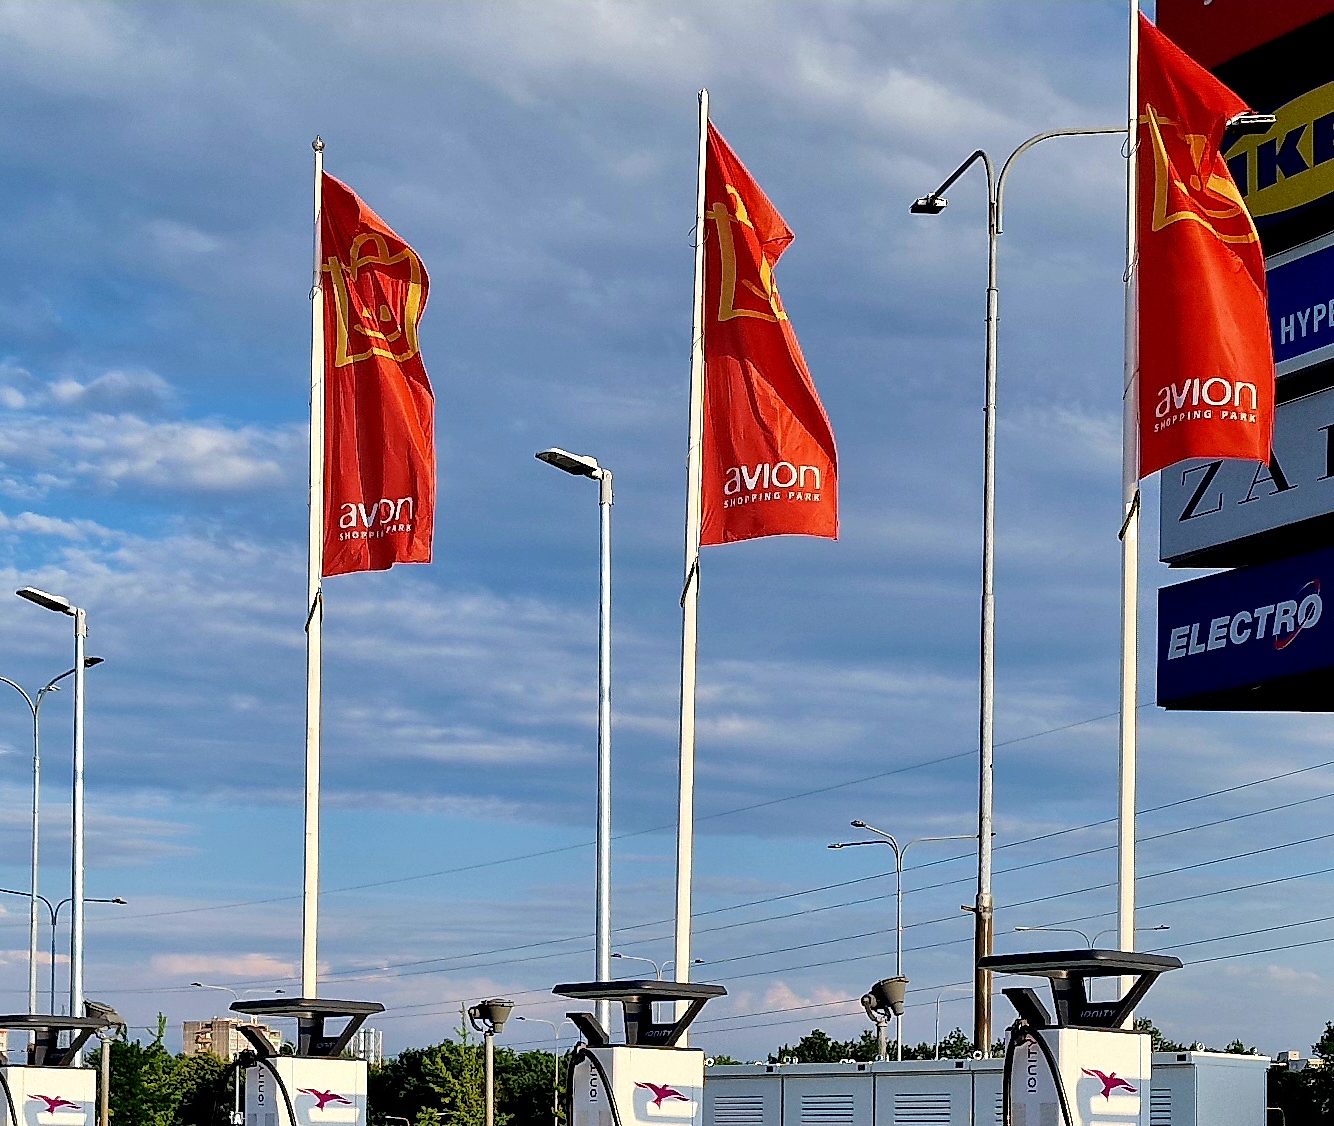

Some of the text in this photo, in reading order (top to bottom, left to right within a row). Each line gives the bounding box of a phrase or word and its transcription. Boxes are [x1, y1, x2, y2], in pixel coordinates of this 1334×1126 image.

[1155, 377, 1257, 418] avion
[1153, 409, 1256, 433] SHOPPING PARK
[724, 461, 820, 496] avion
[339, 496, 413, 529] avon
[723, 491, 821, 509] SHOPPING PARK
[1167, 593, 1323, 661] ELECTRO
[589, 1063, 598, 1102] IONIT
